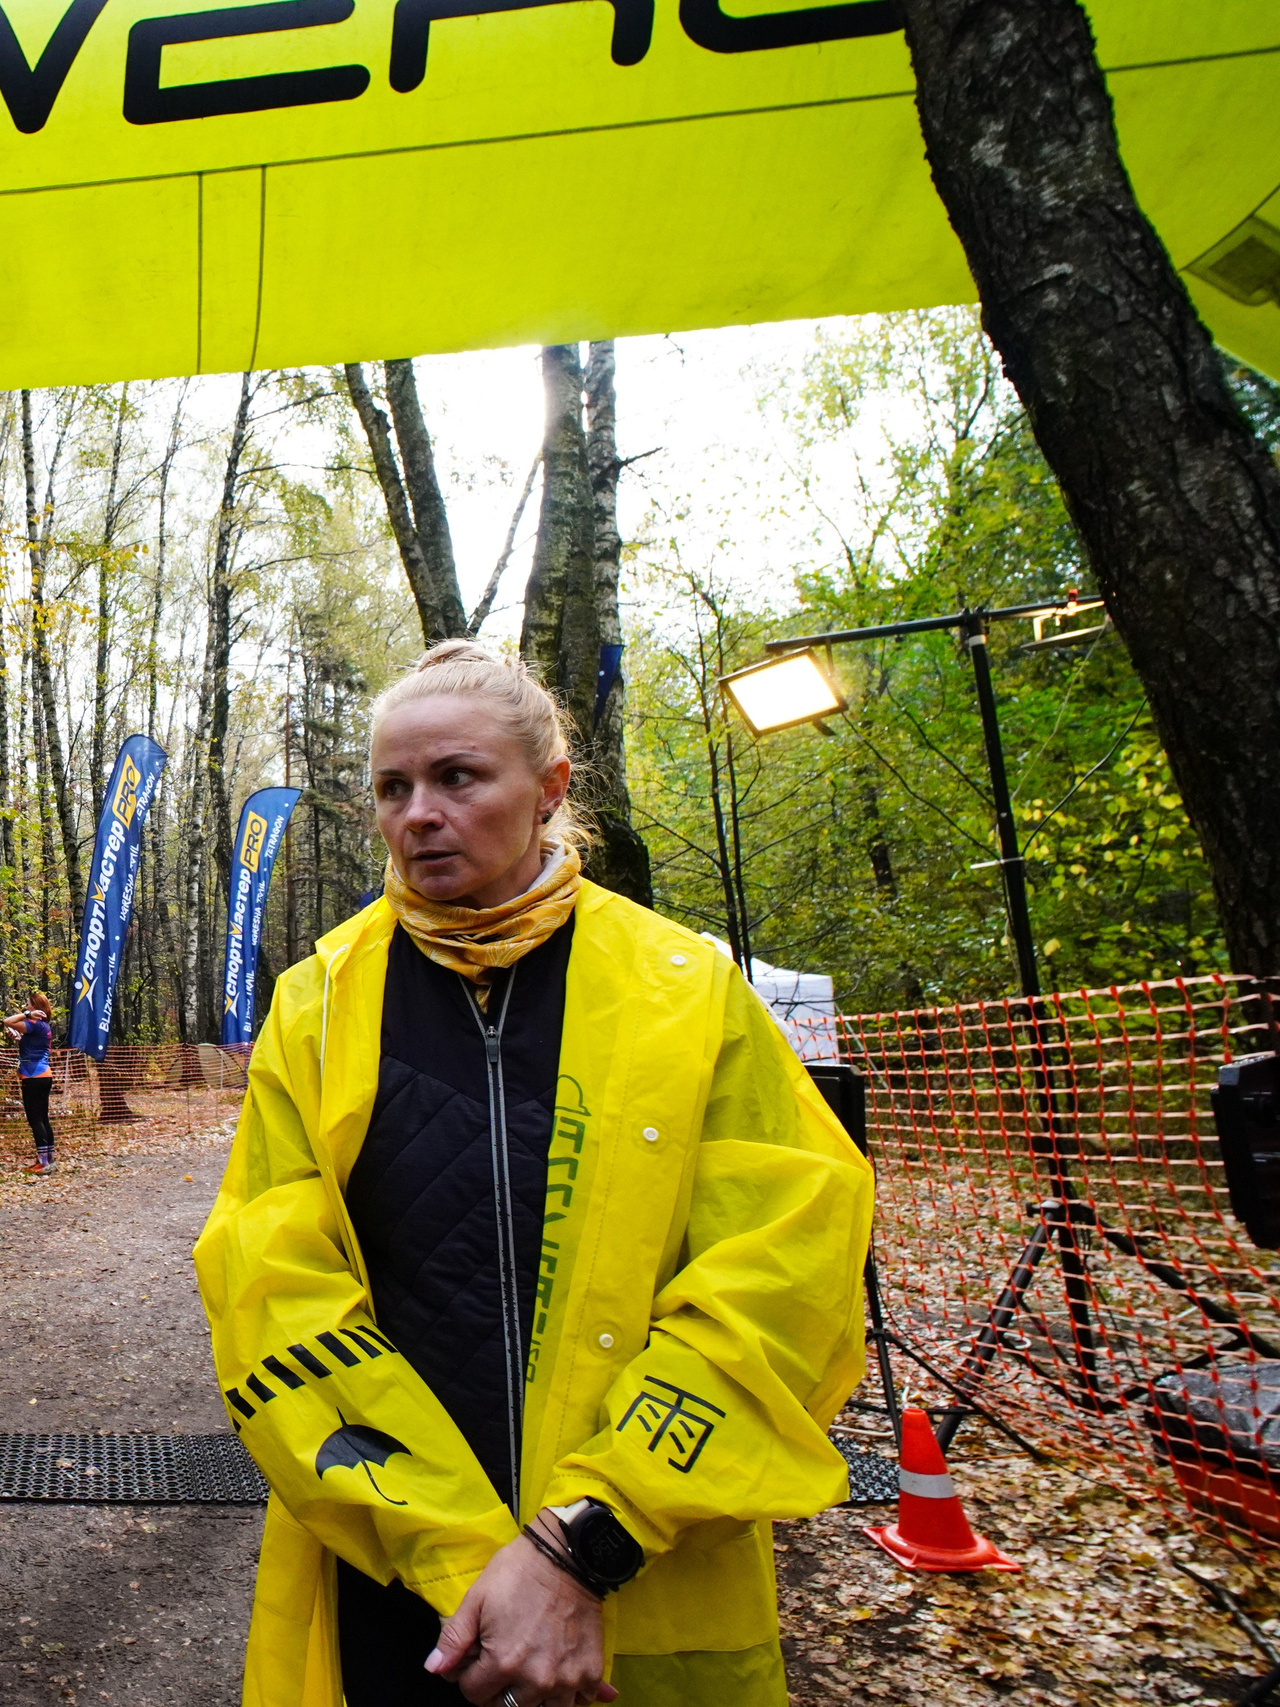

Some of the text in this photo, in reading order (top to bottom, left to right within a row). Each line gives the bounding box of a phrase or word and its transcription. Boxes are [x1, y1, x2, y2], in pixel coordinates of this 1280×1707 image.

[116, 763, 137, 823] PRO
[136, 772, 156, 820] ETRAGON
[243, 818, 263, 867] PRO
[265, 815, 285, 858] TETRAGON
